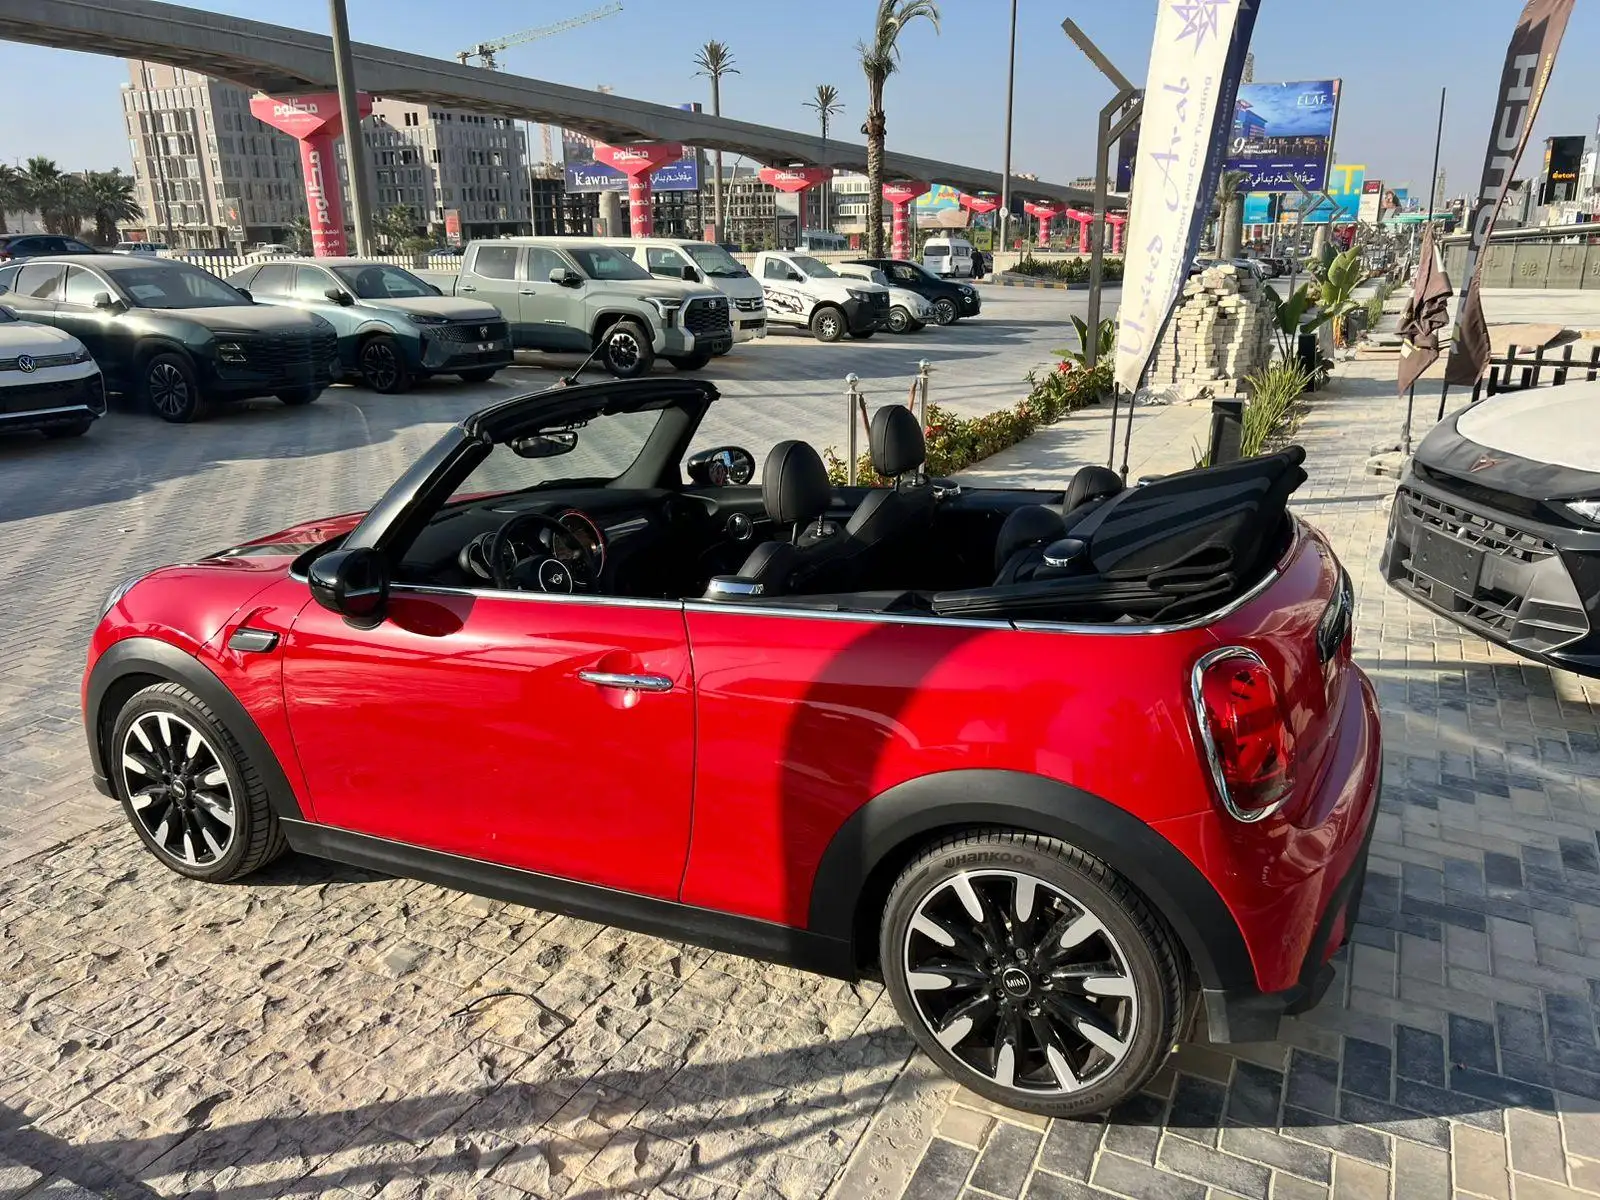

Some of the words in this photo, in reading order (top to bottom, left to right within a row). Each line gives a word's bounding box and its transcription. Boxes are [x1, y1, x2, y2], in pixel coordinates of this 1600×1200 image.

[273, 98, 318, 117] مظلوم
[1297, 95, 1328, 106] ELAF
[1150, 76, 1190, 212] Arab
[1185, 174, 1195, 201] and
[1190, 143, 1199, 168] Car
[1195, 76, 1212, 134] Trading
[1232, 137, 1245, 154] 9
[613, 147, 649, 159] مظلوم
[308, 151, 331, 224] مظلوم
[1006, 977, 1027, 988] MINI
